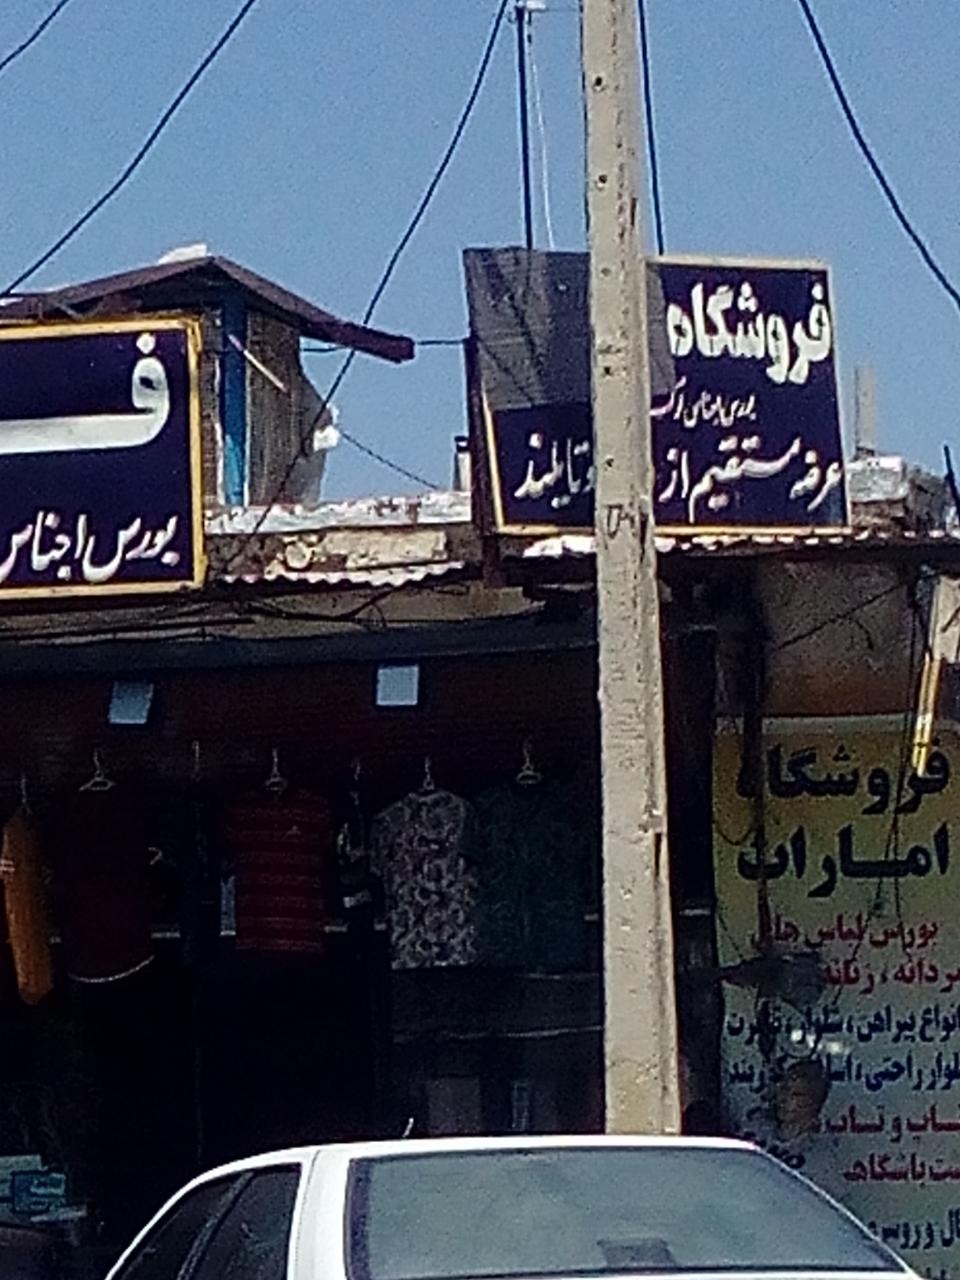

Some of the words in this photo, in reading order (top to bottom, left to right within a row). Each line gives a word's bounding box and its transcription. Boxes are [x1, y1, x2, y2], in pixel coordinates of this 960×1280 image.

[666, 281, 833, 384] فروشگاه
[513, 432, 590, 510] تایلند
[658, 448, 690, 503] از
[688, 435, 801, 524] مستقیم
[789, 450, 842, 512] عرضه
[82, 514, 180, 582] بورس
